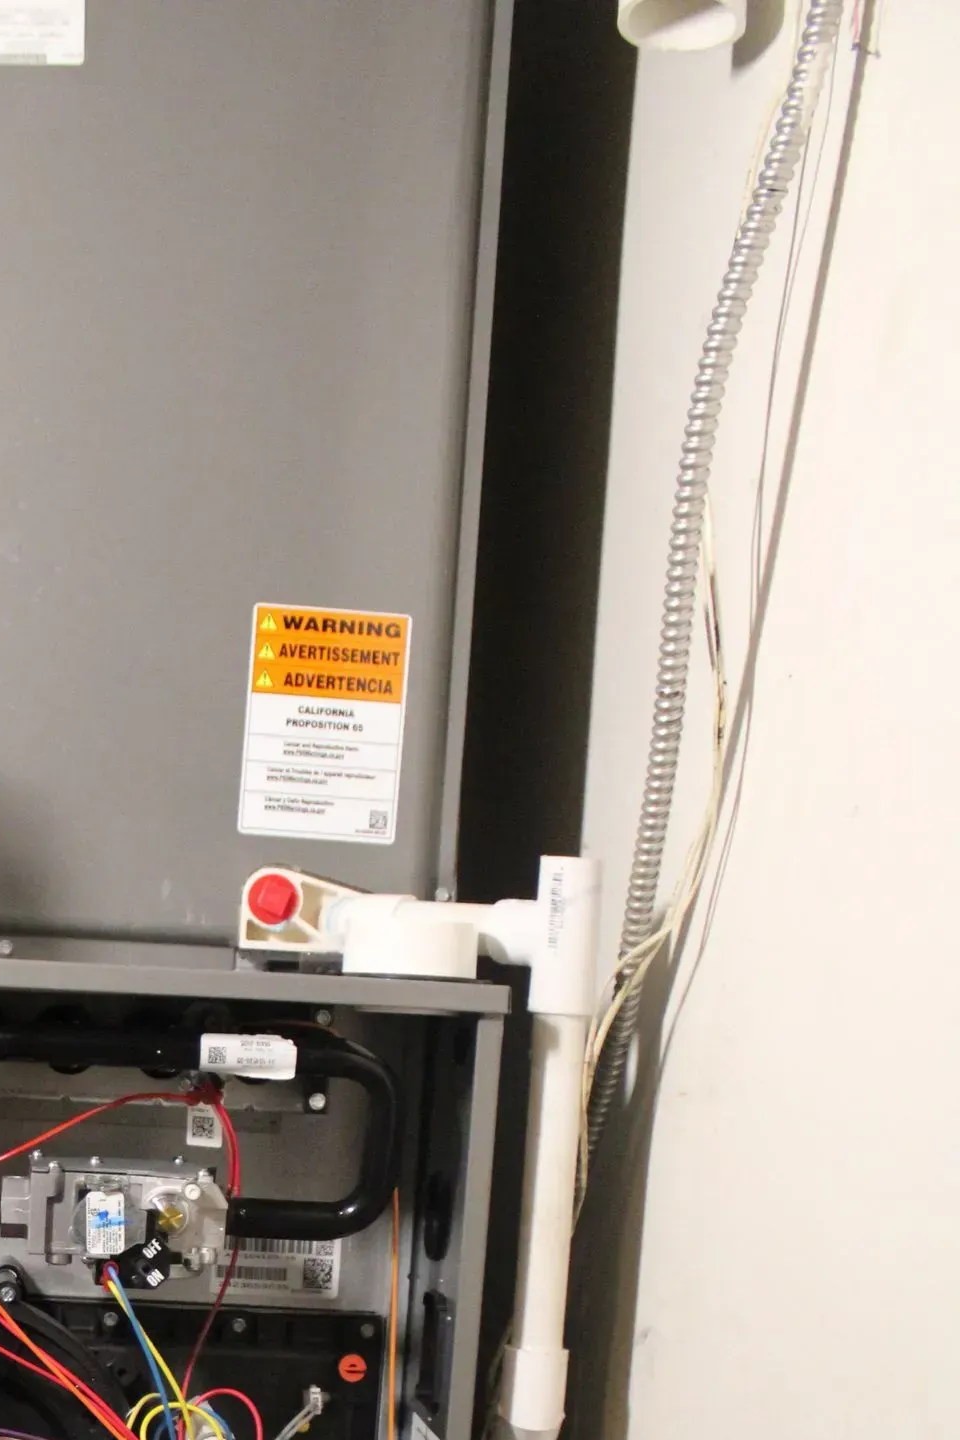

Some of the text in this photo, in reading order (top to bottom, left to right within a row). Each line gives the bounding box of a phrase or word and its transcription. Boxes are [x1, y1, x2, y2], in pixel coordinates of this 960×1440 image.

[283, 615, 401, 638] WARNING
[279, 643, 400, 666] AVERTISSEMENT
[284, 672, 393, 694] ADVERTENCIA
[298, 706, 355, 717] CALIFORNIA
[286, 719, 364, 732] PROPOSITION 65
[142, 1238, 162, 1259] OFF
[146, 1268, 165, 1287] ON
